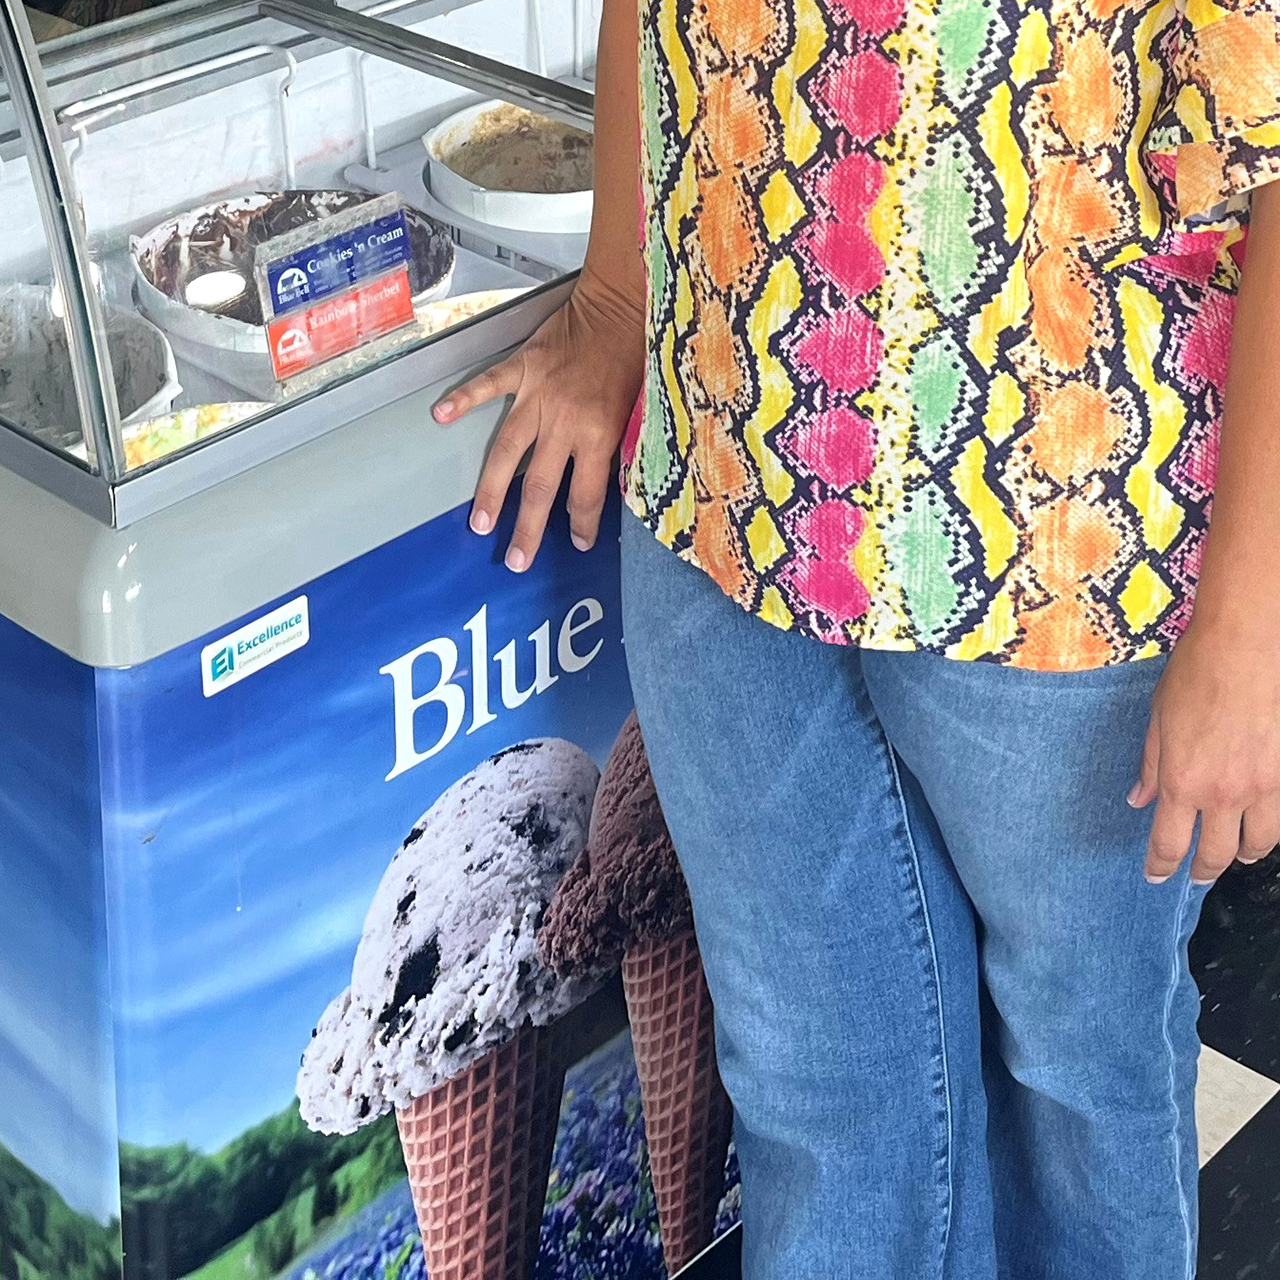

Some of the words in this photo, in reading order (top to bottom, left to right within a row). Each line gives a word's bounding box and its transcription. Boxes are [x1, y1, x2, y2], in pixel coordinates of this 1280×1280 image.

[367, 227, 404, 248] Cream
[310, 302, 357, 328] Rainbow
[237, 613, 302, 655] Excellence
[379, 597, 604, 782] Blue
